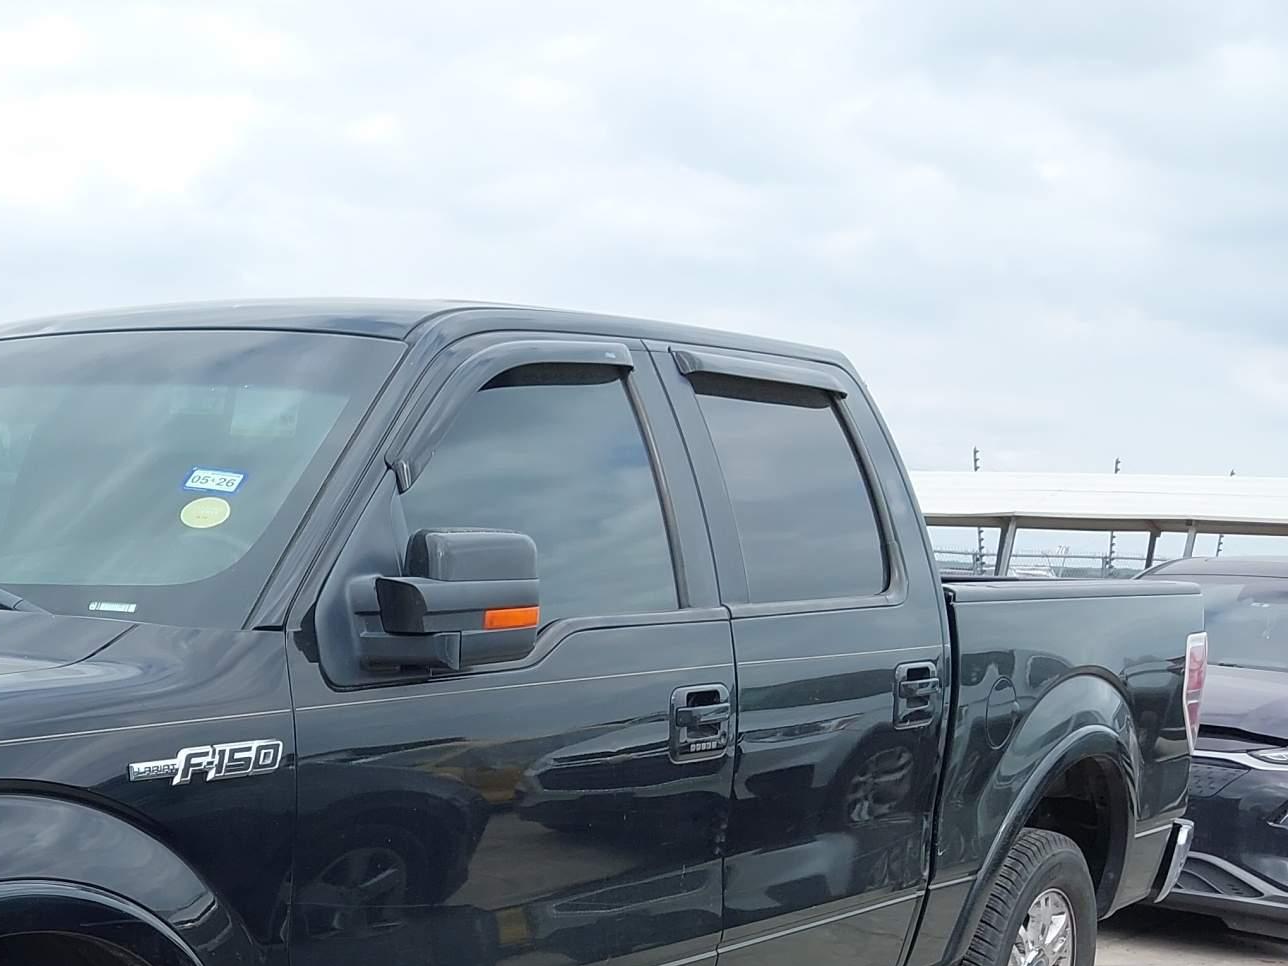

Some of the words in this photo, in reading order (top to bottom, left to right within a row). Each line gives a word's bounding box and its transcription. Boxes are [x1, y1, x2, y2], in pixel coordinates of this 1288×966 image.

[191, 475, 211, 485] 05
[216, 477, 236, 487] 26
[133, 764, 177, 777] LARIAT
[175, 740, 283, 784] F-150
